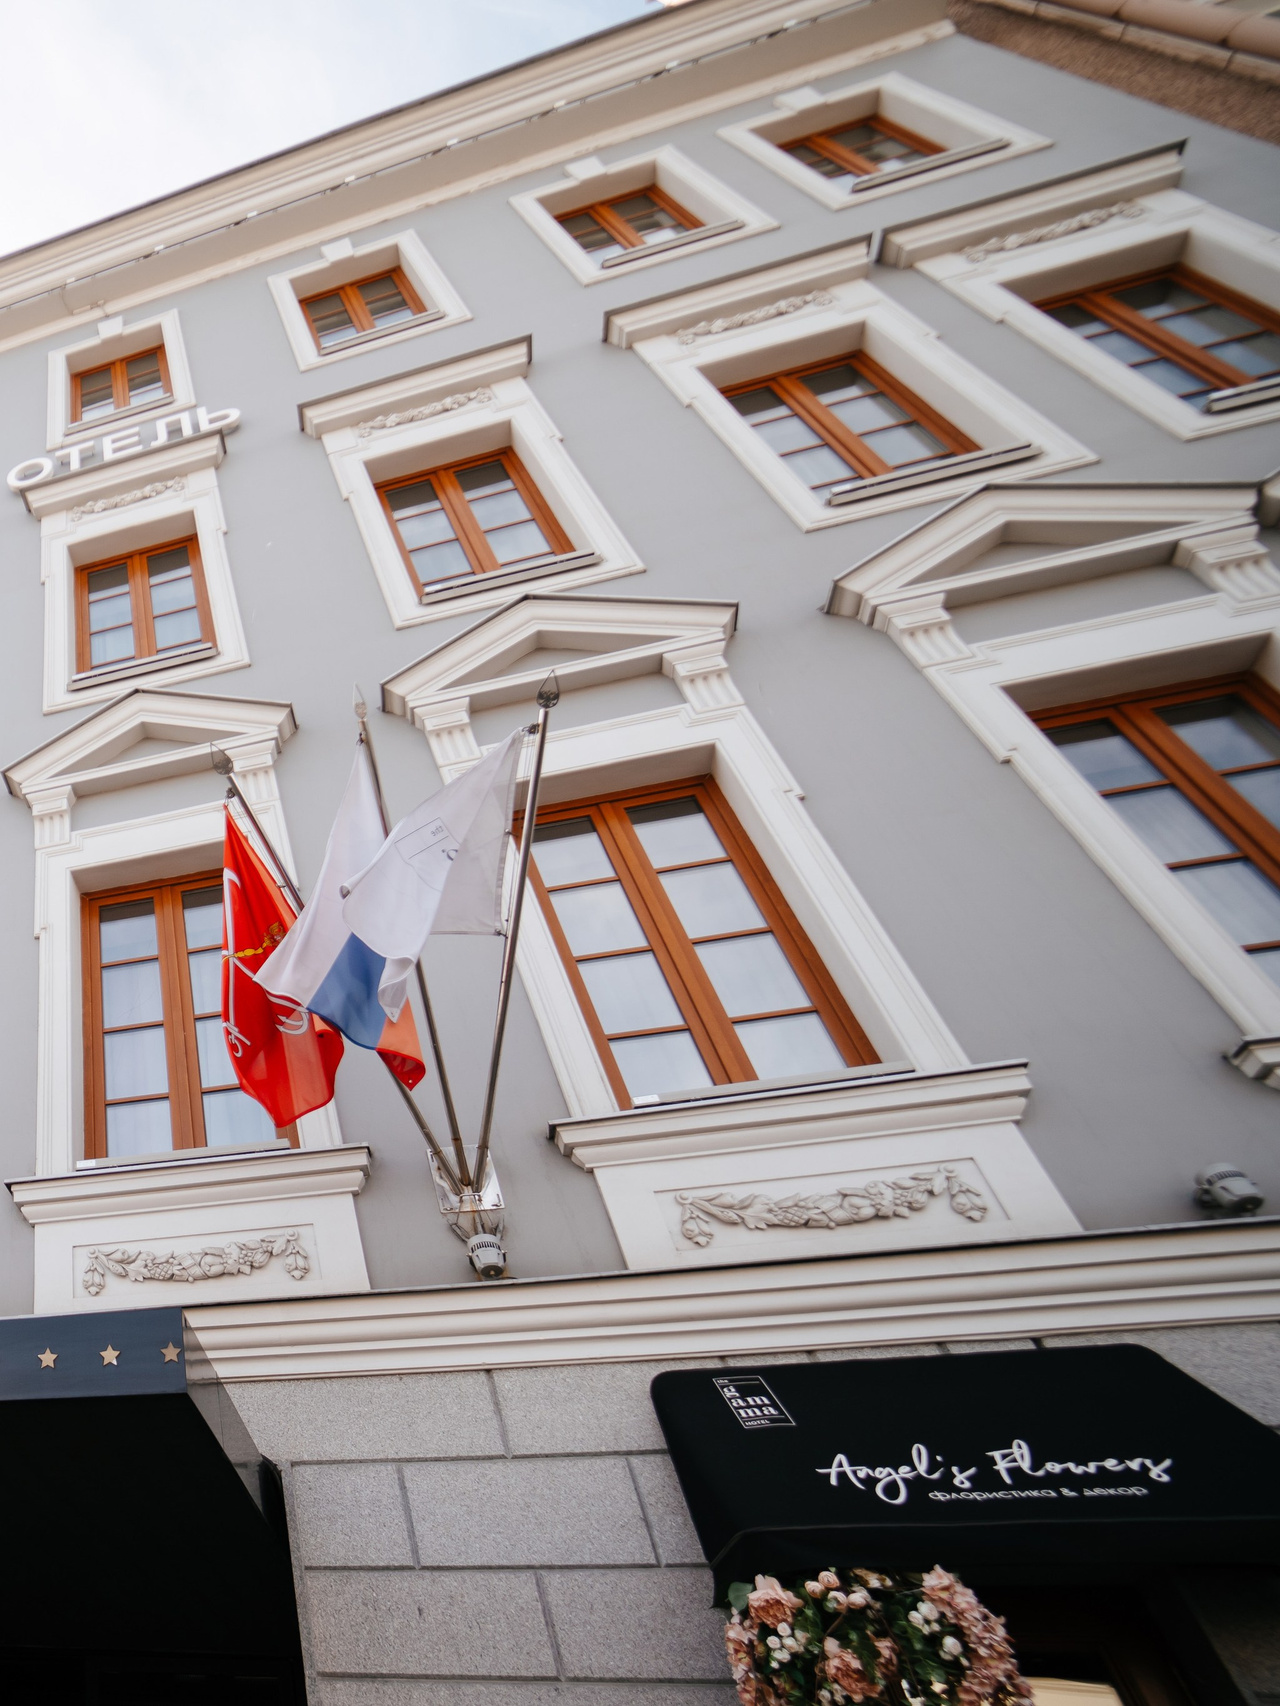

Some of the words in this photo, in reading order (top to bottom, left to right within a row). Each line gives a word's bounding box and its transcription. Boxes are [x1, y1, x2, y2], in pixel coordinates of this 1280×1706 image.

[7, 406, 241, 492] ОТЕЛЬ
[815, 1443, 978, 1505] Angel's
[985, 1439, 1172, 1485] Flowers
[928, 1488, 1058, 1502] флористика
[1059, 1486, 1079, 1497] &
[1082, 1486, 1149, 1497] декор
